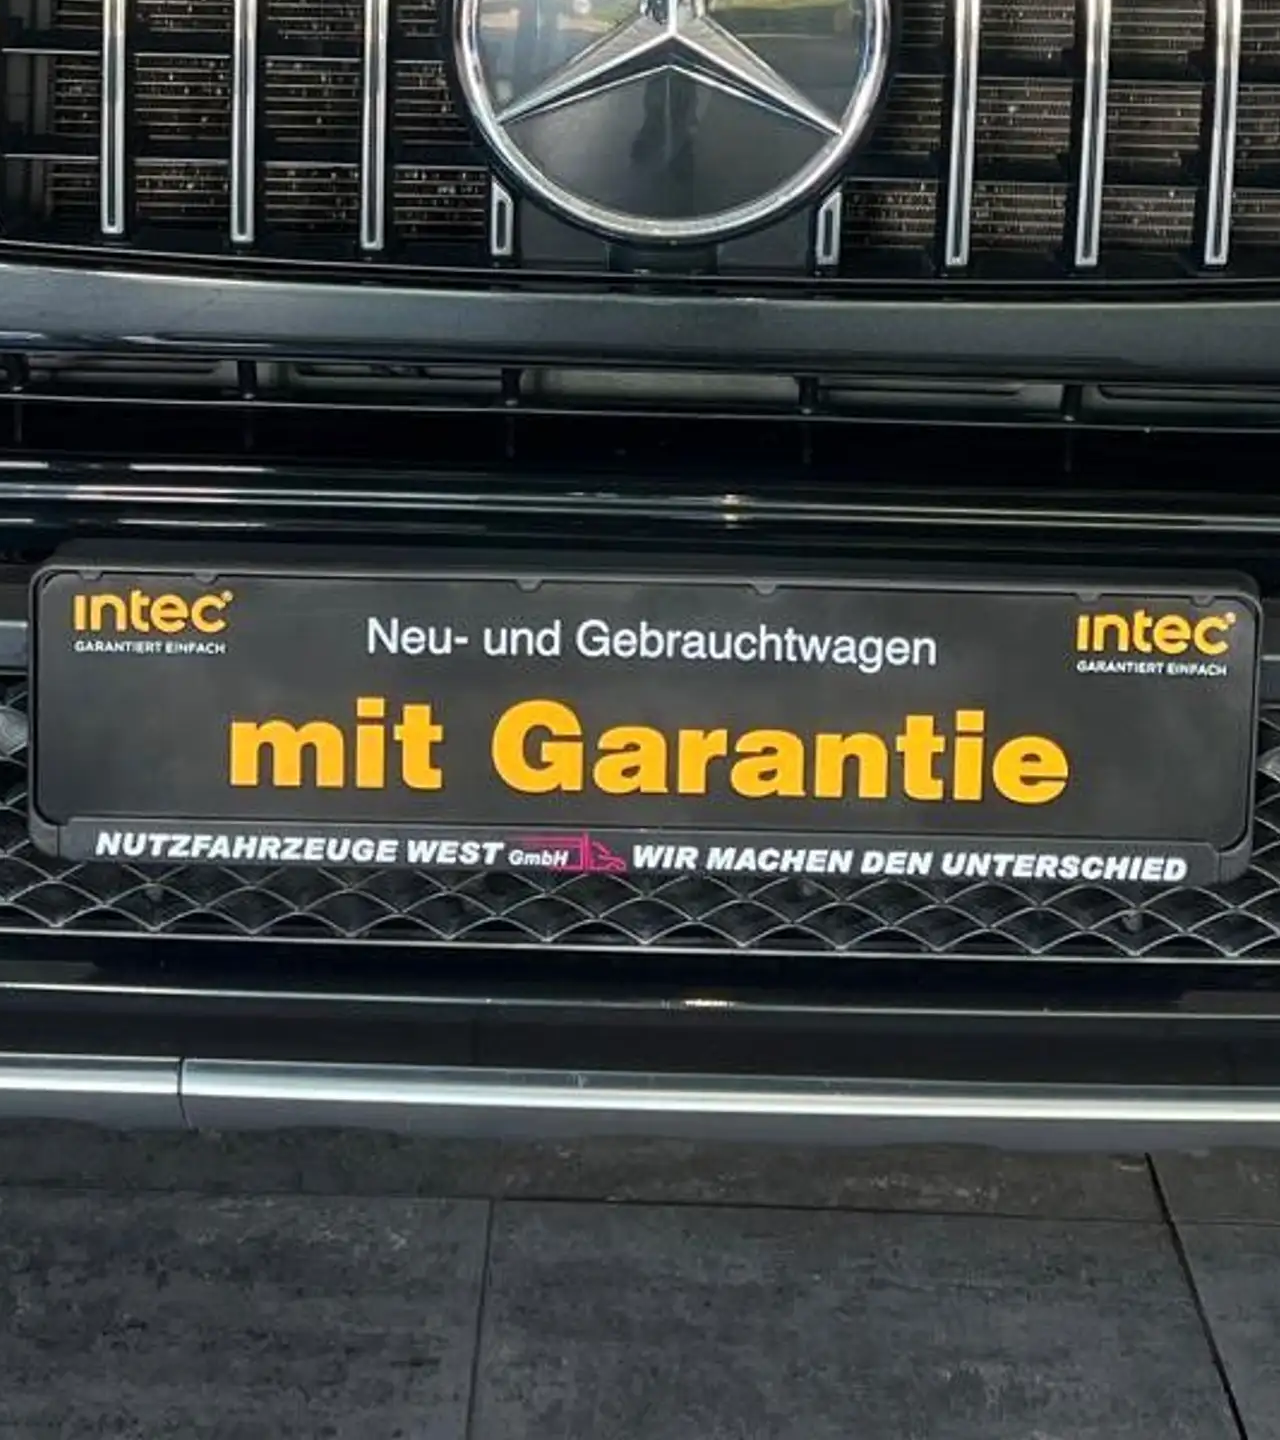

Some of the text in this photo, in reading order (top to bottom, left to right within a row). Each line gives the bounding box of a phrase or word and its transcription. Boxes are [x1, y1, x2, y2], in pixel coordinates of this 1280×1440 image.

[74, 640, 226, 655] GARANTIERT EINFACH
[367, 617, 937, 673] Neu- und Gebrauchtwagen
[1077, 660, 1227, 676] GARANTIERT EINFACH
[230, 697, 1069, 804] mit Garantie
[95, 831, 569, 867] NUTZFAHRZEUGE WEST GmbH
[632, 844, 1188, 882] WIR MACHEN DEN UNTERSCHIED
